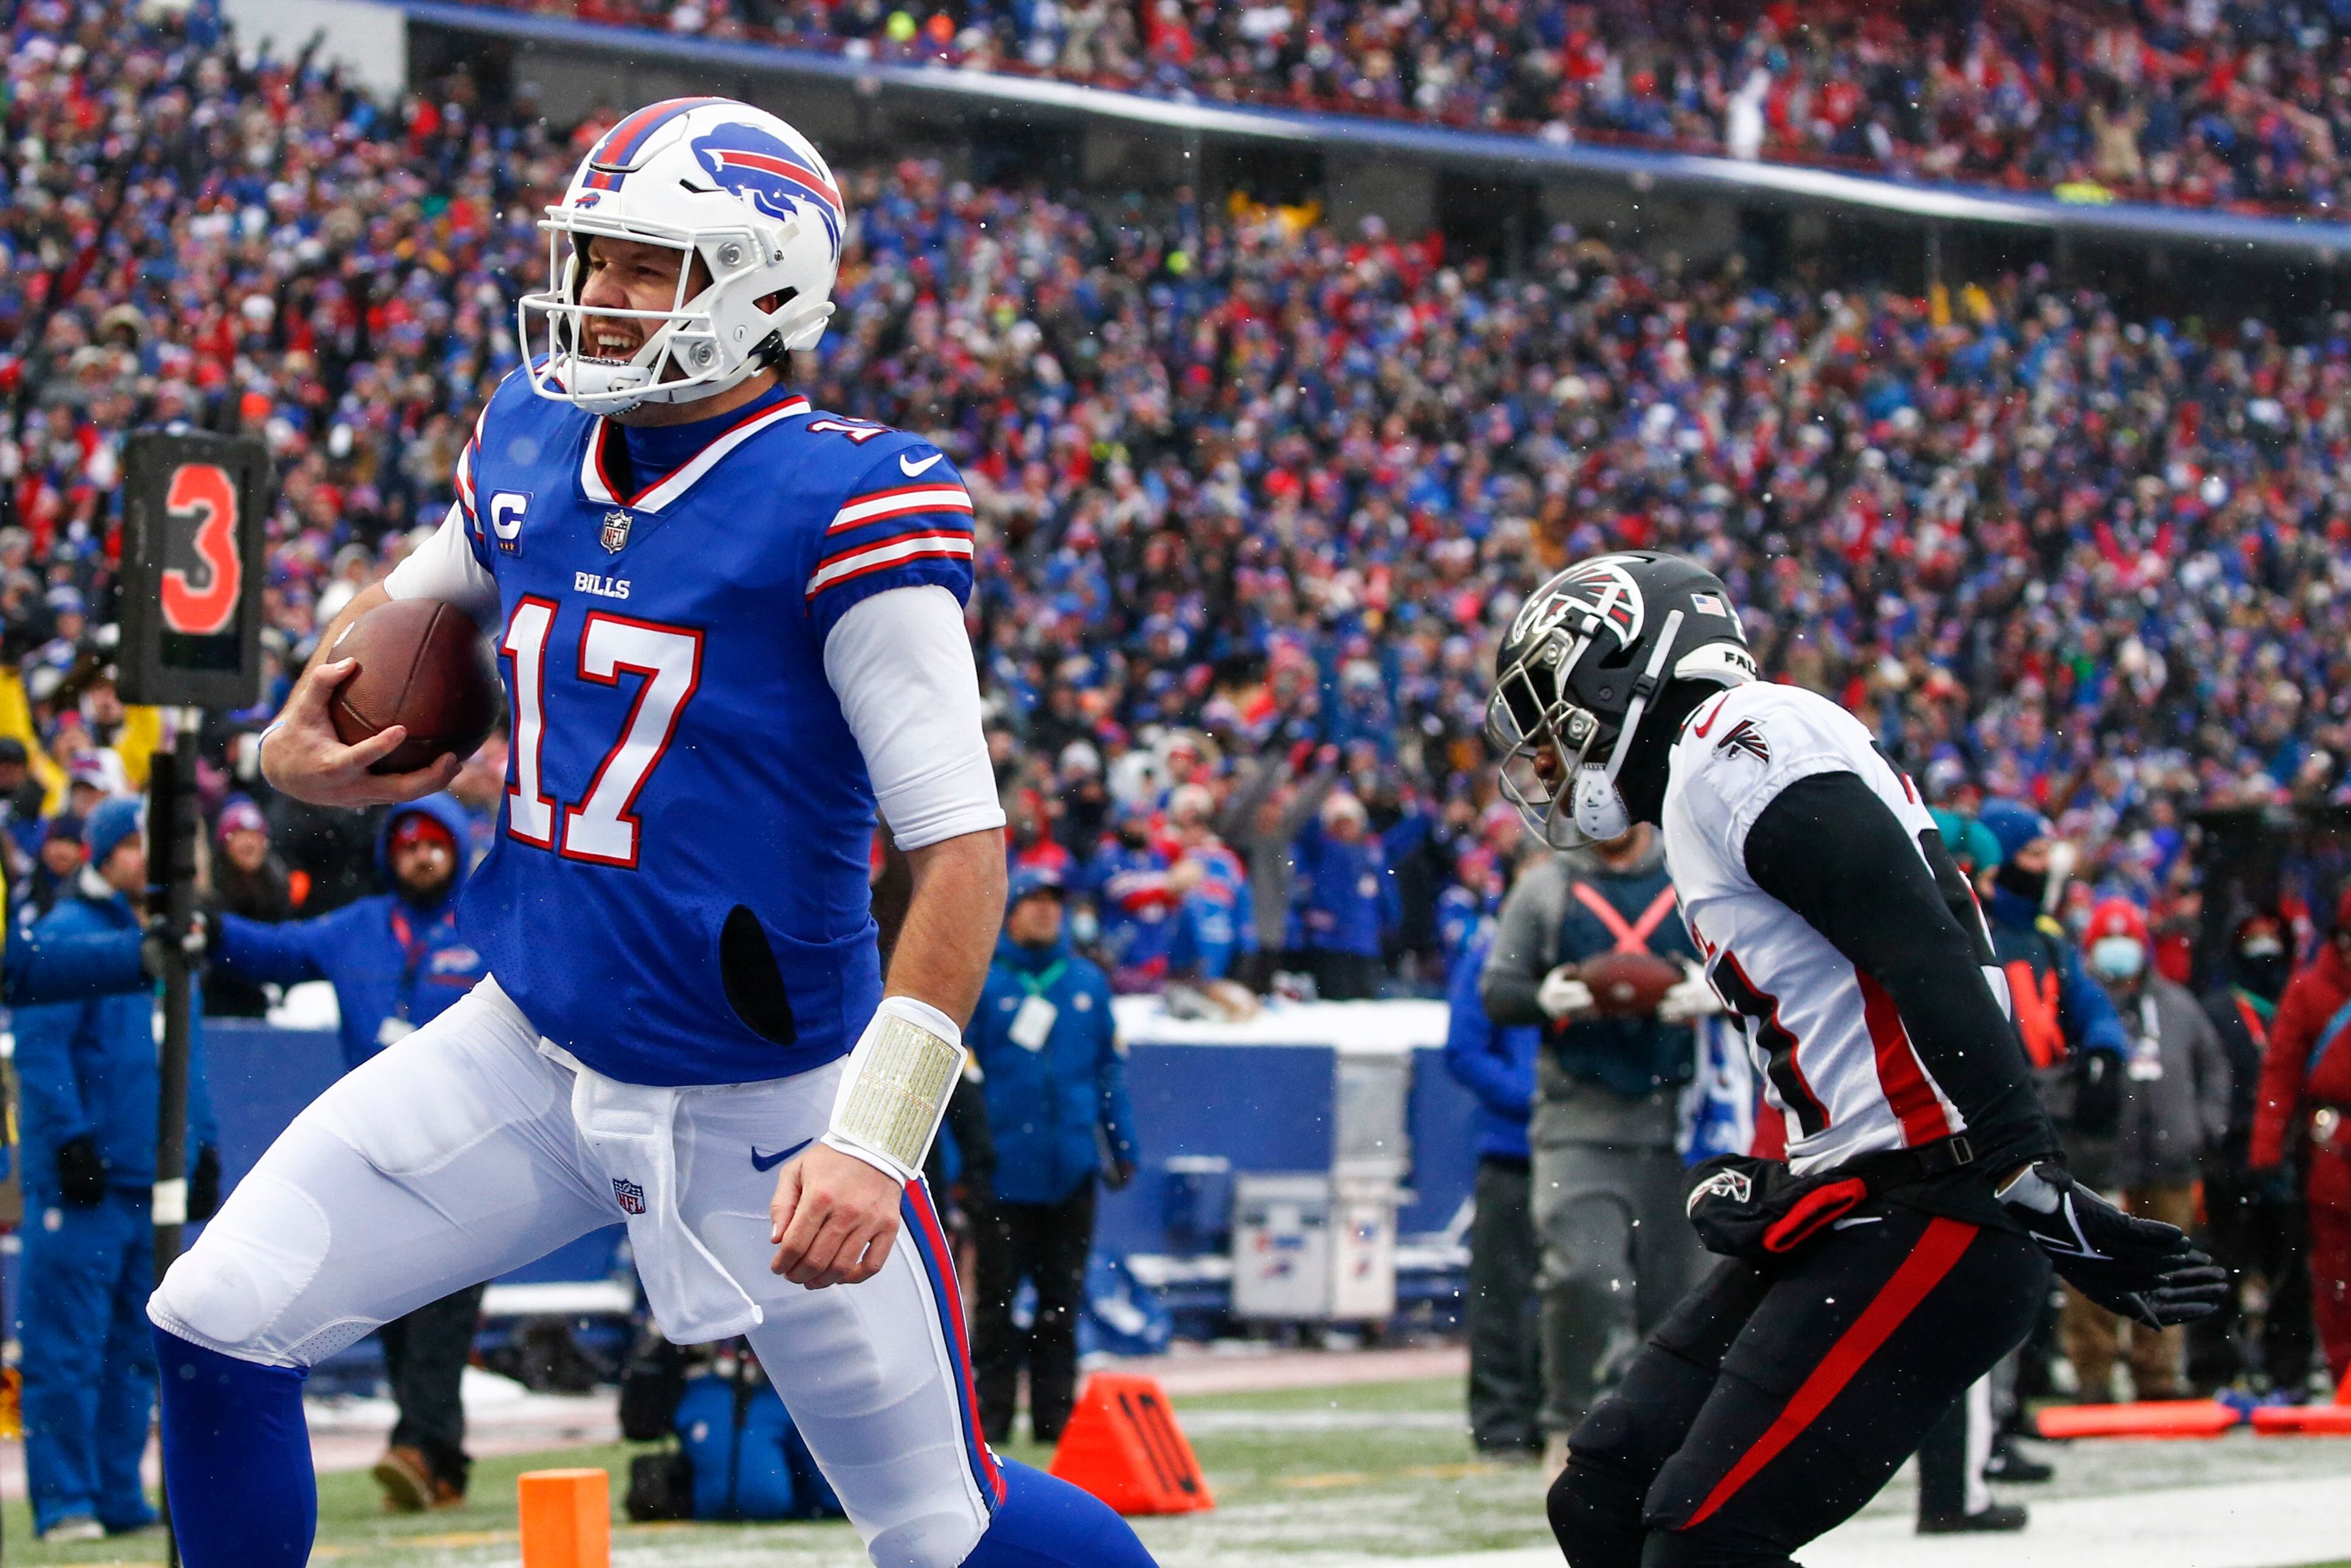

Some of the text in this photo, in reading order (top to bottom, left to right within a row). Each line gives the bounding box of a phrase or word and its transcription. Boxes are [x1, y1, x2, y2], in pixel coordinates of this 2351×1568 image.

[806, 416, 899, 446] 1
[490, 493, 527, 539] C
[161, 464, 241, 635] 3
[604, 527, 624, 546] NFL
[574, 571, 631, 600] BILLS
[499, 594, 705, 871] 17
[618, 1191, 644, 1213] NFL
[1117, 1391, 1199, 1494] 10
